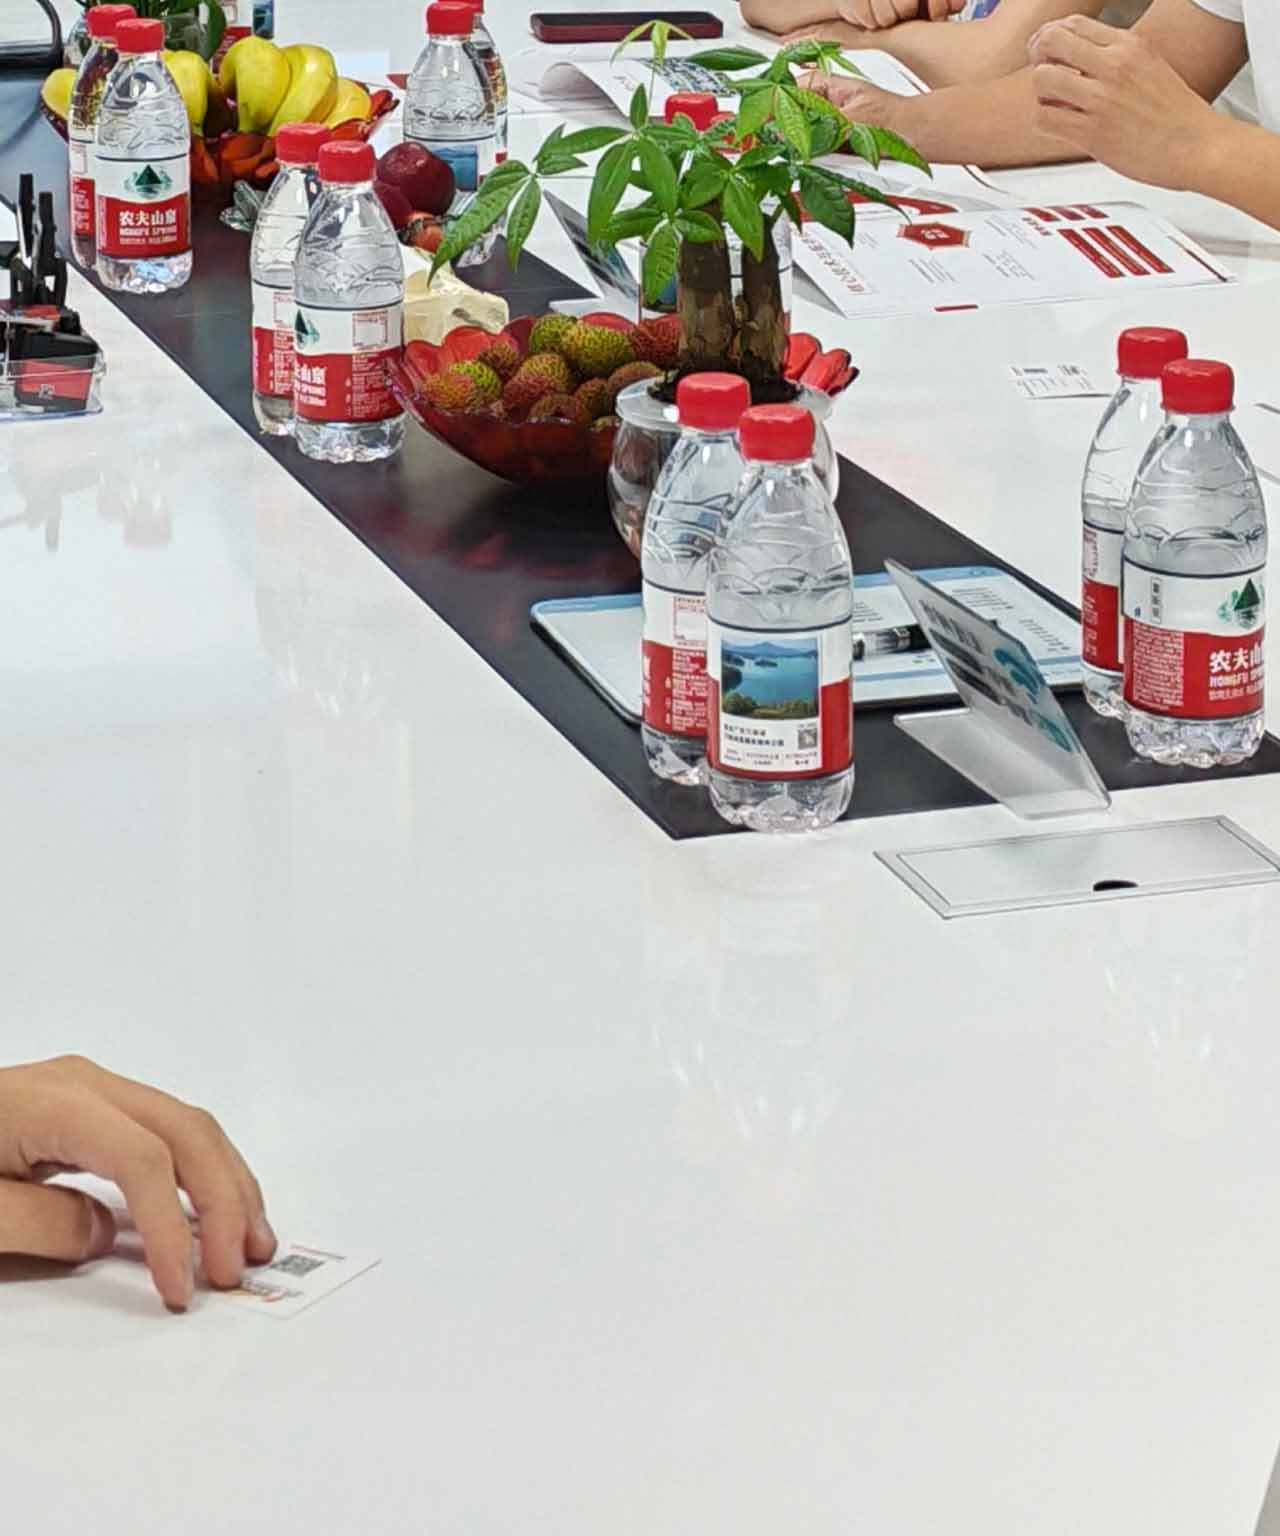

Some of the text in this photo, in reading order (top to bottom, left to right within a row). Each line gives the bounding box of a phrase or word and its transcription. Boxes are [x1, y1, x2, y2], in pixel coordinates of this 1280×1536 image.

[119, 209, 177, 227] 农夫山泉
[1209, 640, 1265, 673] 农夫山
